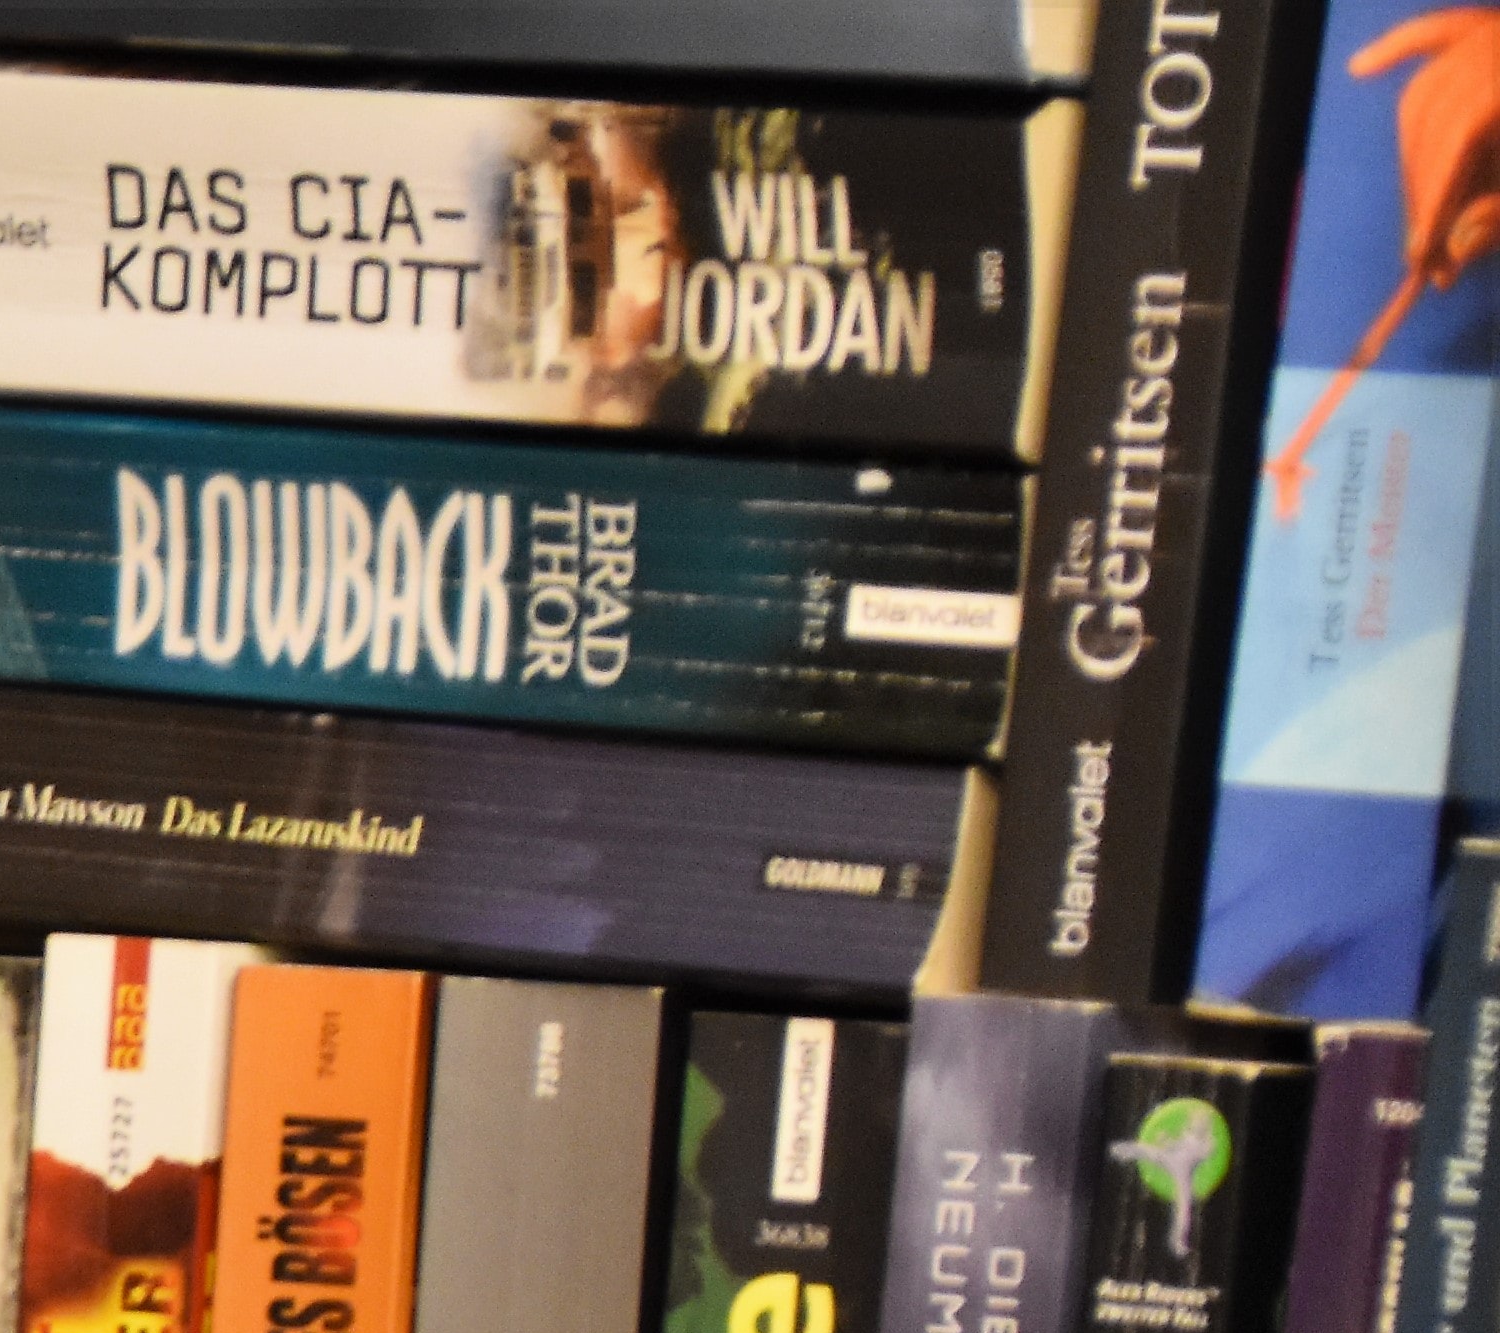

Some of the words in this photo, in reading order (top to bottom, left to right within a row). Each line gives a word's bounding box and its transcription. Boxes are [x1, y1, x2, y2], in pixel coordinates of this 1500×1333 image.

[99, 242, 484, 333] KOMPLOTT
[104, 164, 248, 236] DAS
[290, 171, 469, 249] CIA-
[711, 170, 869, 267] WILL
[651, 257, 934, 378] JORDAN
[1065, 269, 1188, 684] Gerritsen
[115, 468, 515, 683] BLOWBACK
[524, 493, 580, 687] THOR
[584, 497, 637, 688] BRAD
[18, 780, 147, 835] Mawson
[161, 796, 222, 840] Das
[226, 798, 422, 857] Lazaruskind
[1049, 738, 1113, 957] blanvalet
[258, 1115, 369, 1285] BÖSEN
